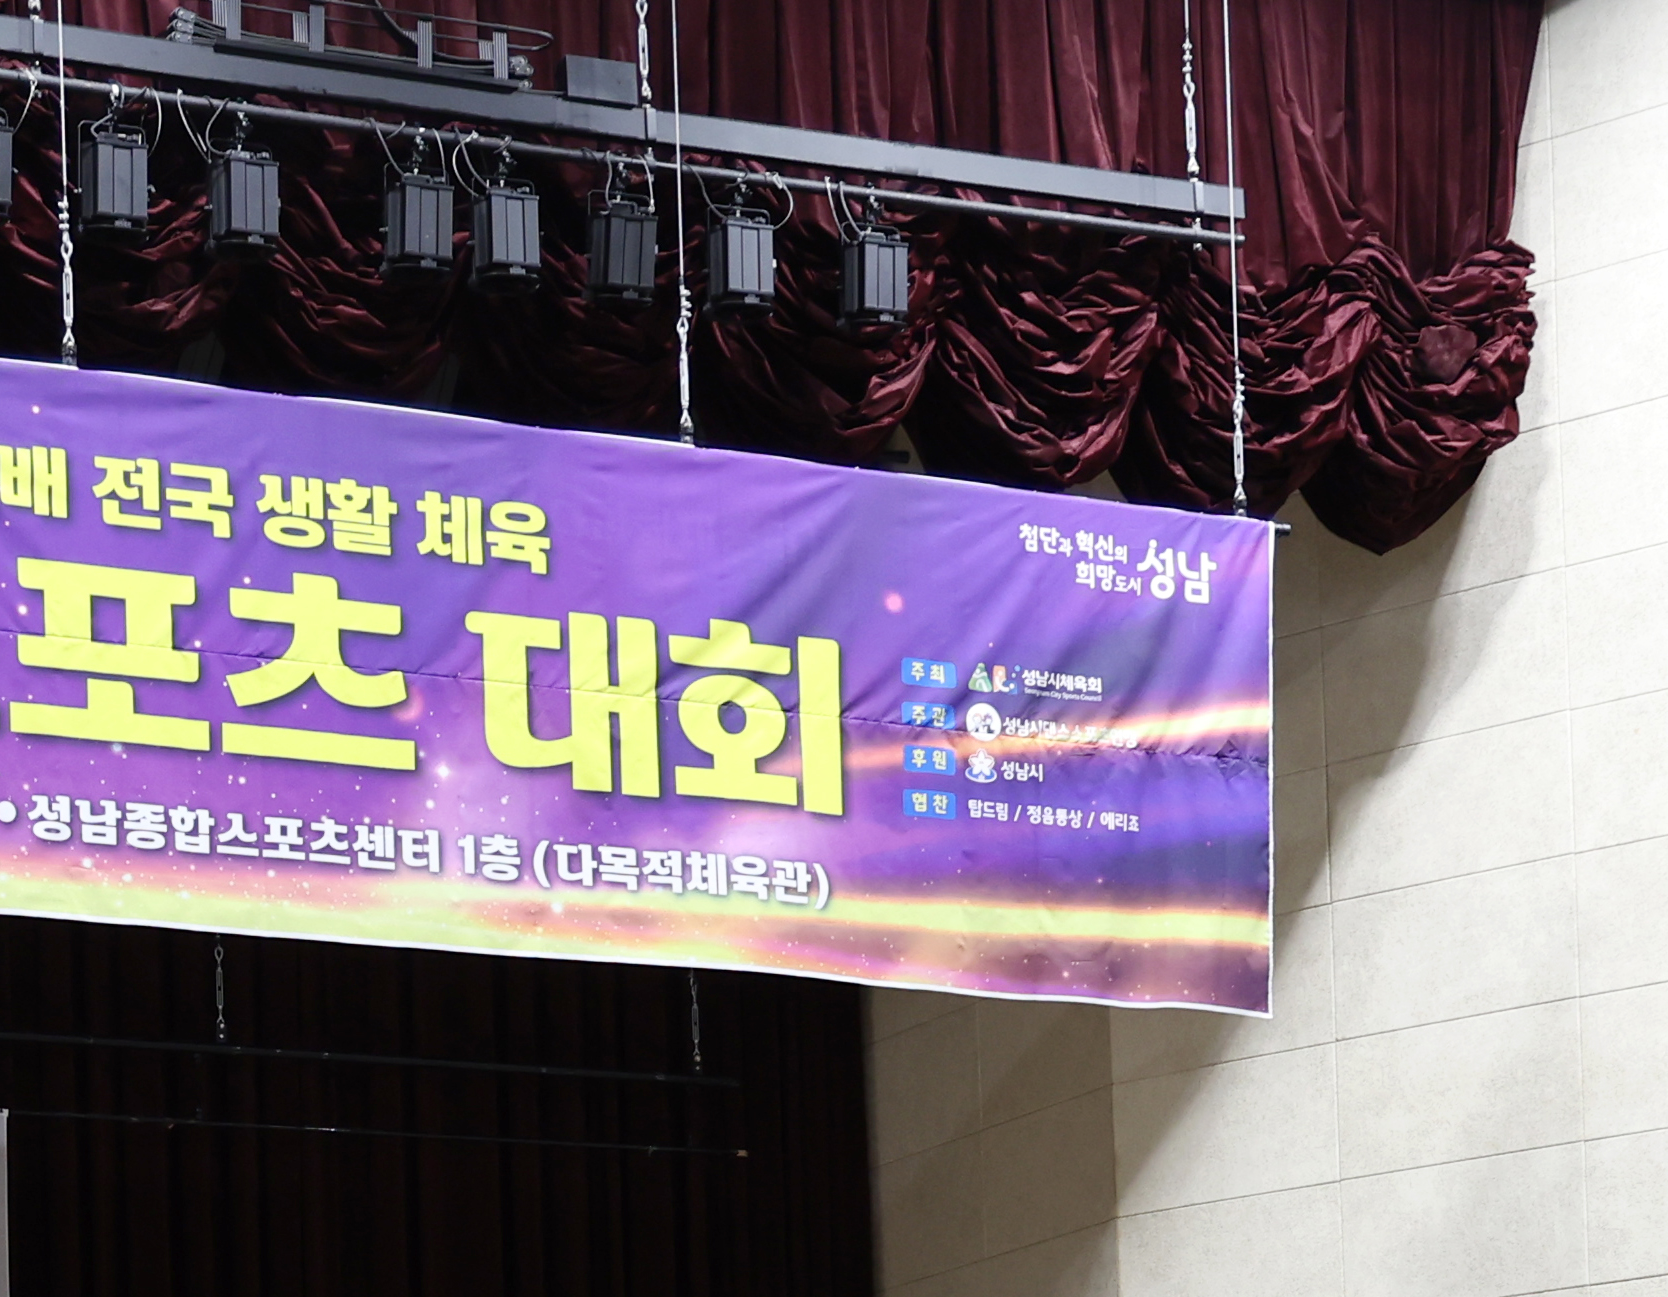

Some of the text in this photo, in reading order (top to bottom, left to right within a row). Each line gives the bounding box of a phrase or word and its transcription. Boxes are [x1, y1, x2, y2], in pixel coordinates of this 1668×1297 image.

[92, 453, 234, 539] 전국
[256, 474, 396, 556] 생활
[416, 489, 550, 574] 체육
[1019, 523, 1127, 564] 첨단과 혁신의
[1075, 561, 1141, 596] 희망도시
[1136, 539, 1217, 604] 성남
[1022, 669, 1102, 693] 성남시체육회
[464, 611, 844, 816] 대회
[1001, 761, 1043, 782] 성남시
[967, 799, 1008, 821] 탑드림
[26, 794, 440, 872] 성남종합스포츠센터
[457, 834, 520, 881] 1층
[533, 839, 831, 909] (다목적체육관)
